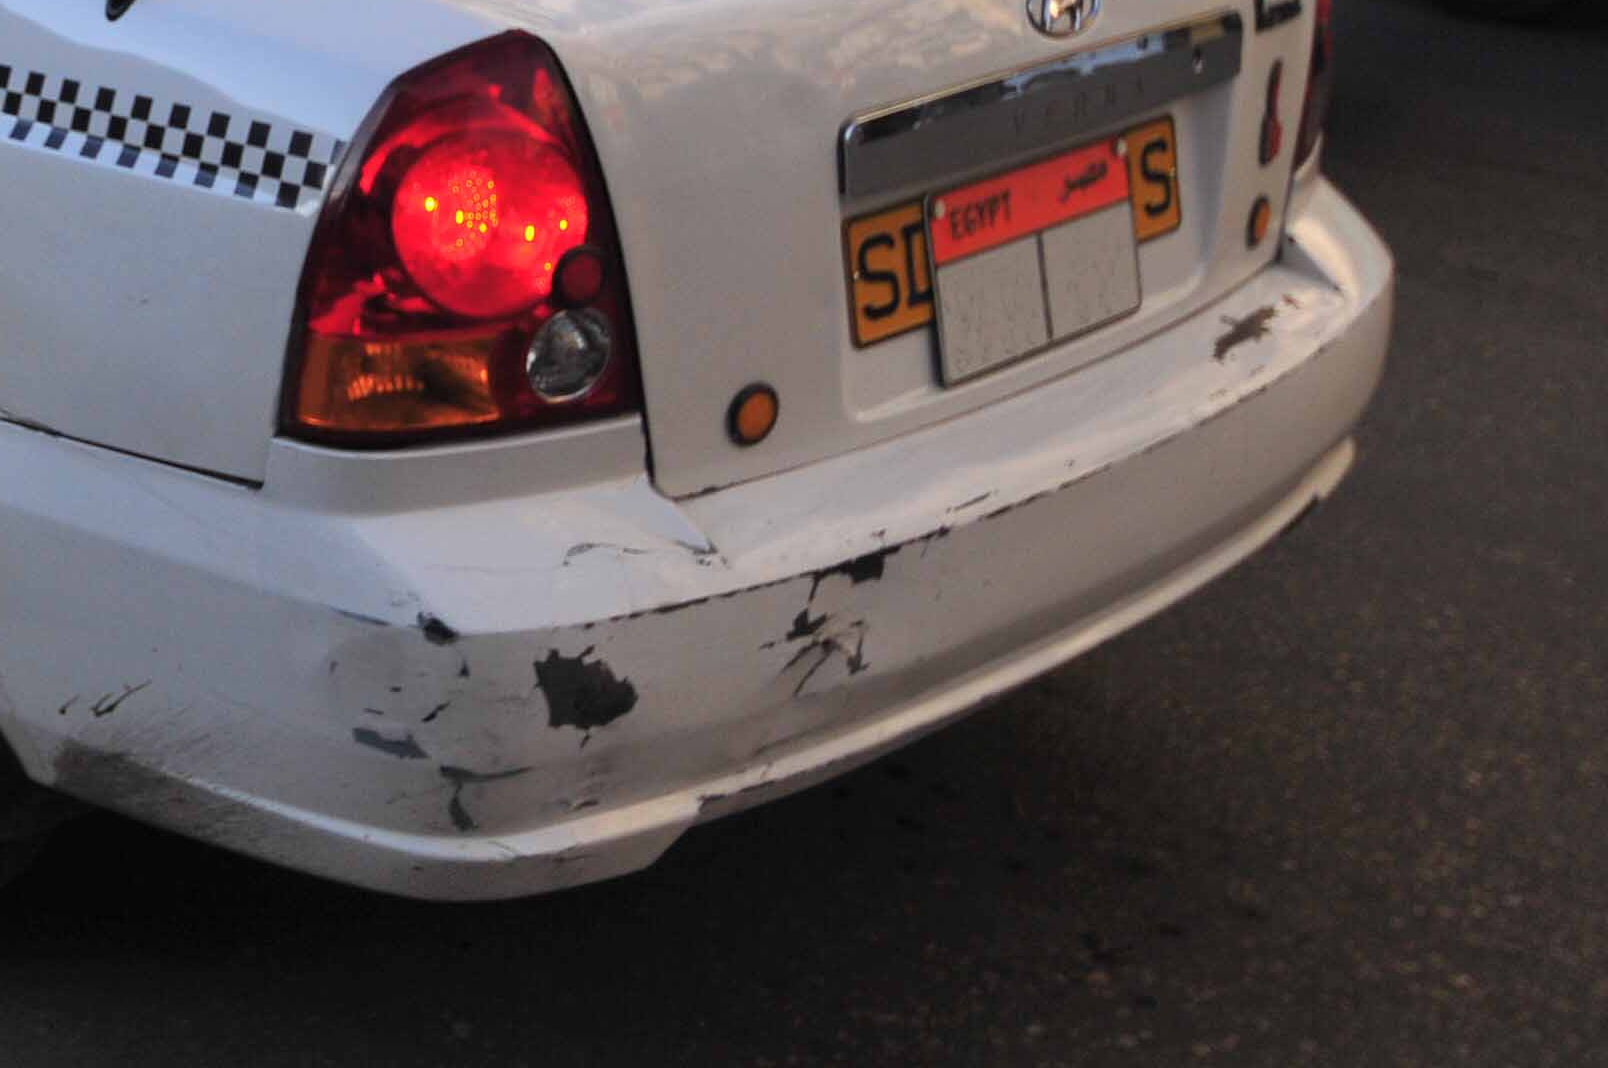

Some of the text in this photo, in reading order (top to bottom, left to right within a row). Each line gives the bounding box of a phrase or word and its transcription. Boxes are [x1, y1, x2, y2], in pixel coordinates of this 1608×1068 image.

[1060, 160, 1109, 203] مصر
[1140, 138, 1174, 219] S
[949, 189, 1013, 240] EGYPT
